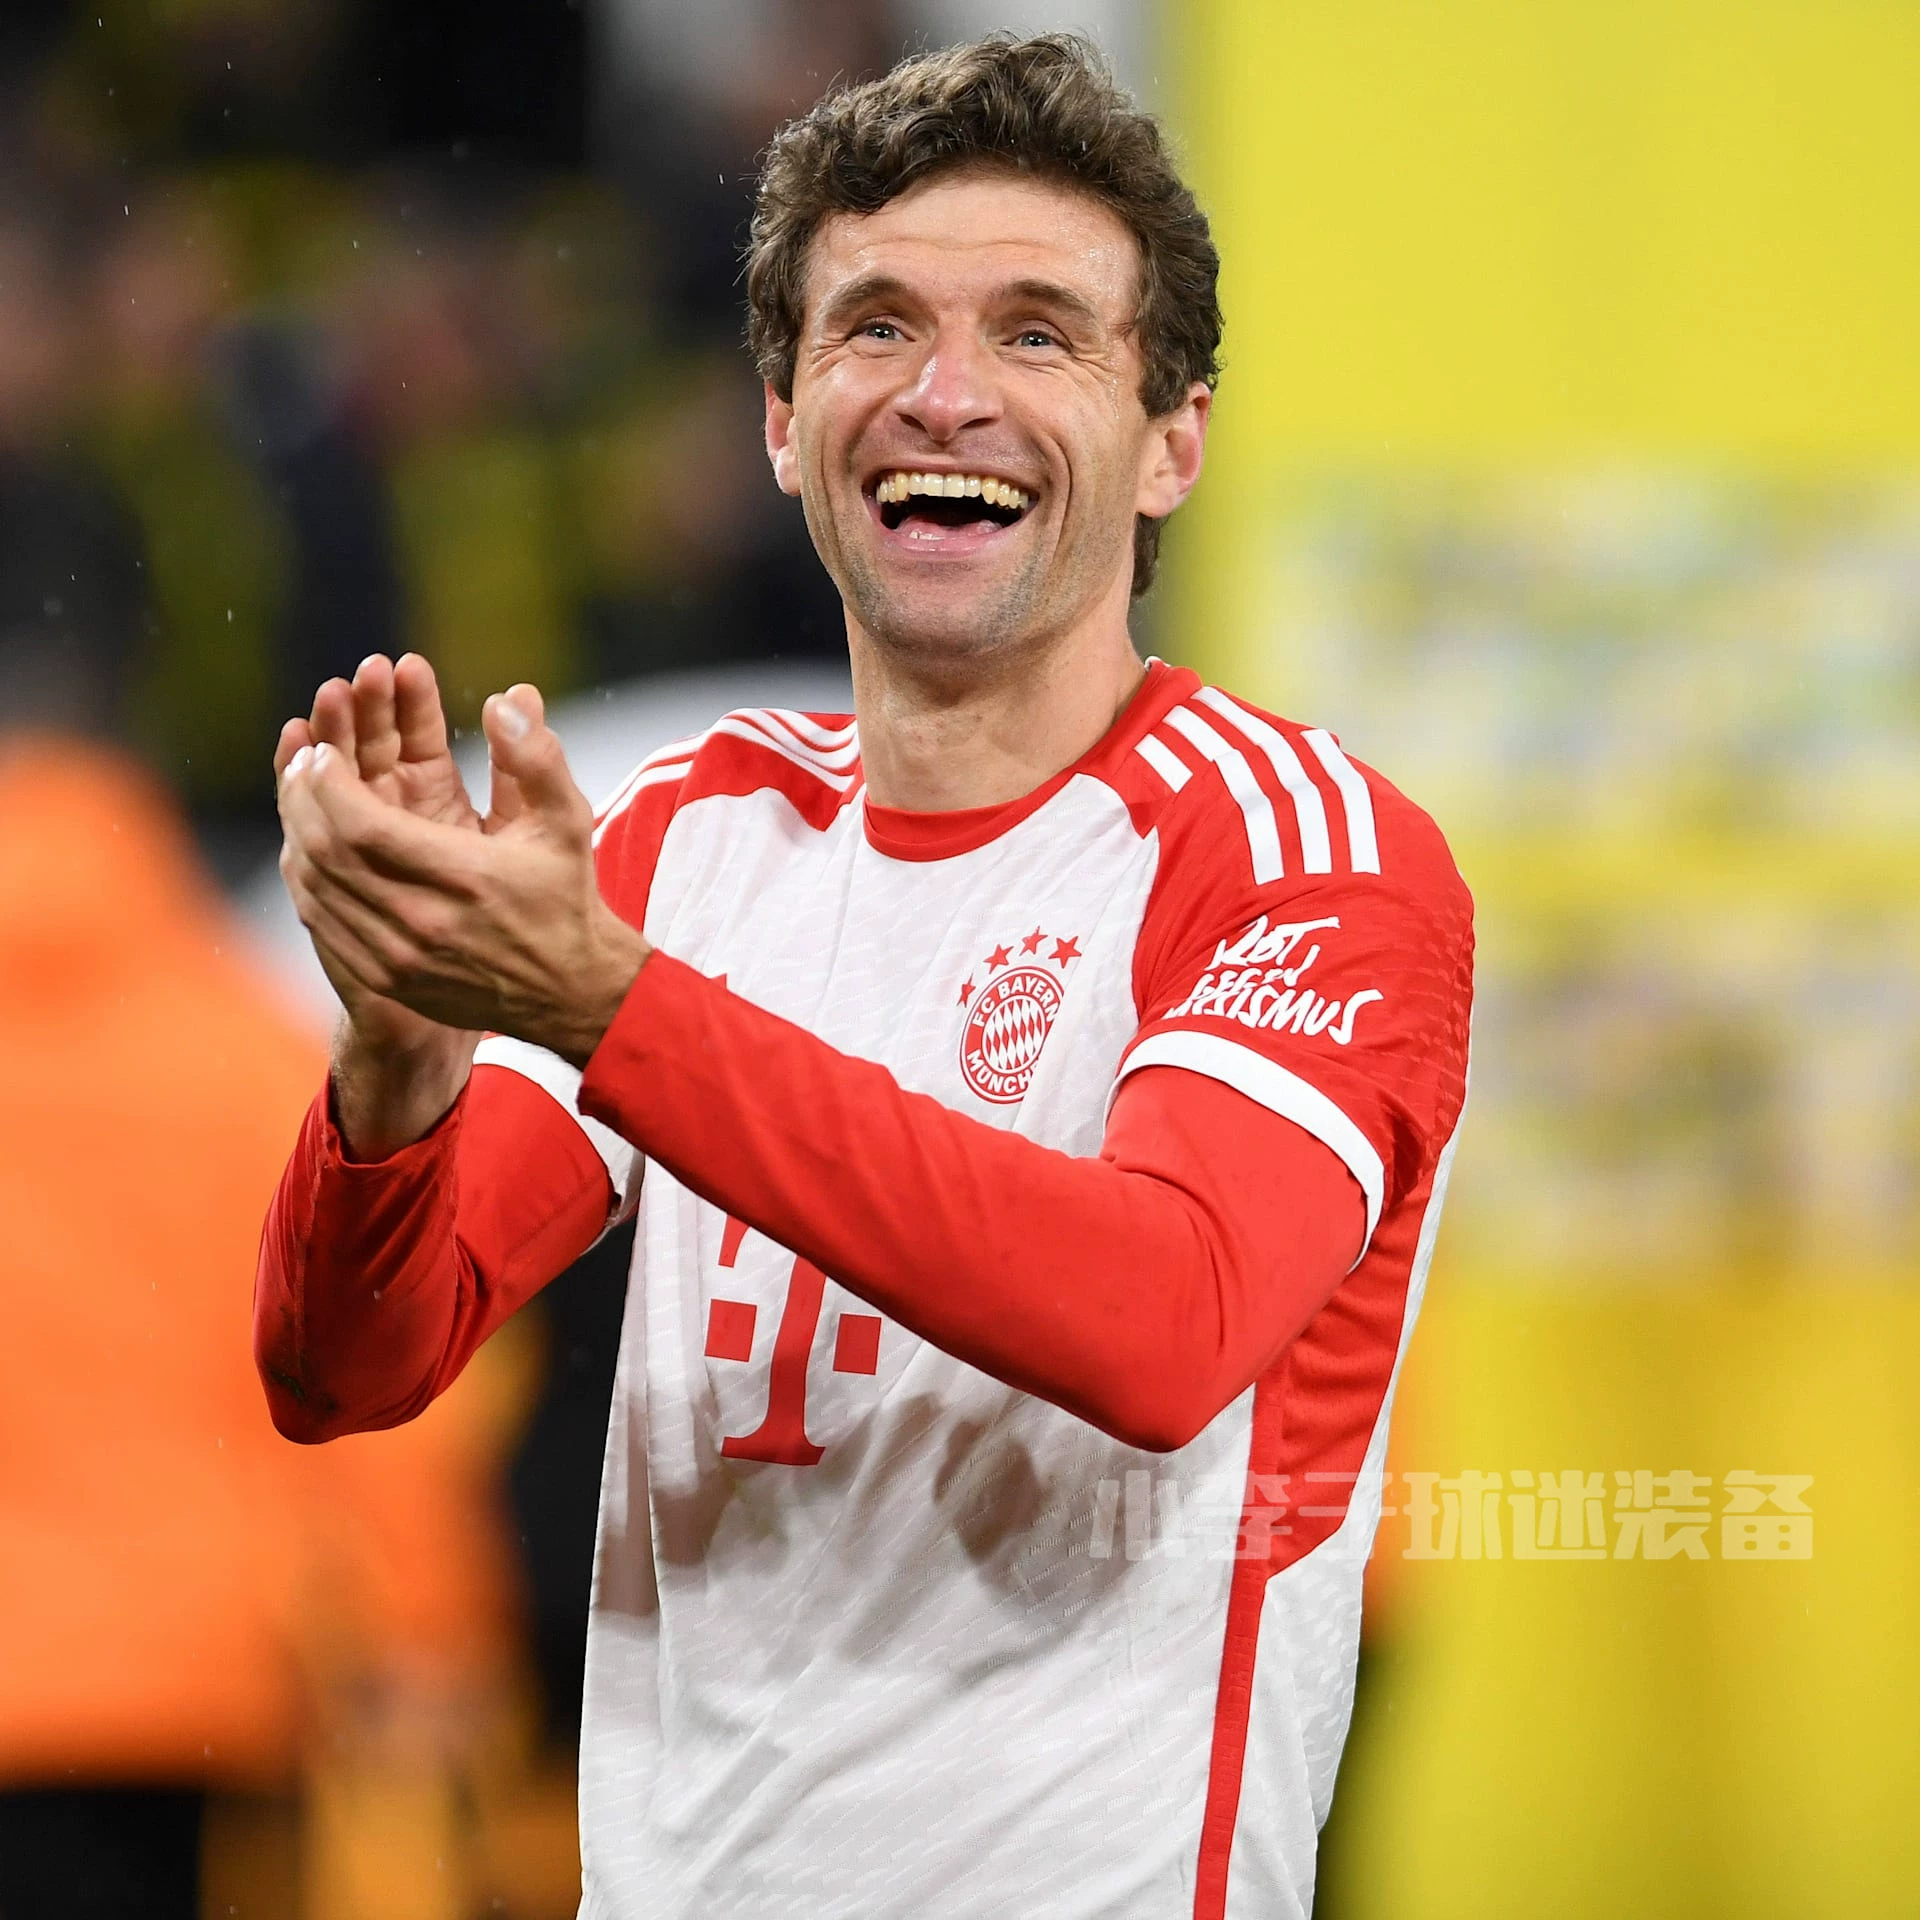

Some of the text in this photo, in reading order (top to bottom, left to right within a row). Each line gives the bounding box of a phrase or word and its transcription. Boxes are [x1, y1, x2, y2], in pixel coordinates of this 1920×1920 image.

[1204, 914, 1341, 971] ROT
[971, 975, 1060, 1028] FC BAYERN
[966, 1048, 1034, 1094] MÜNCH
